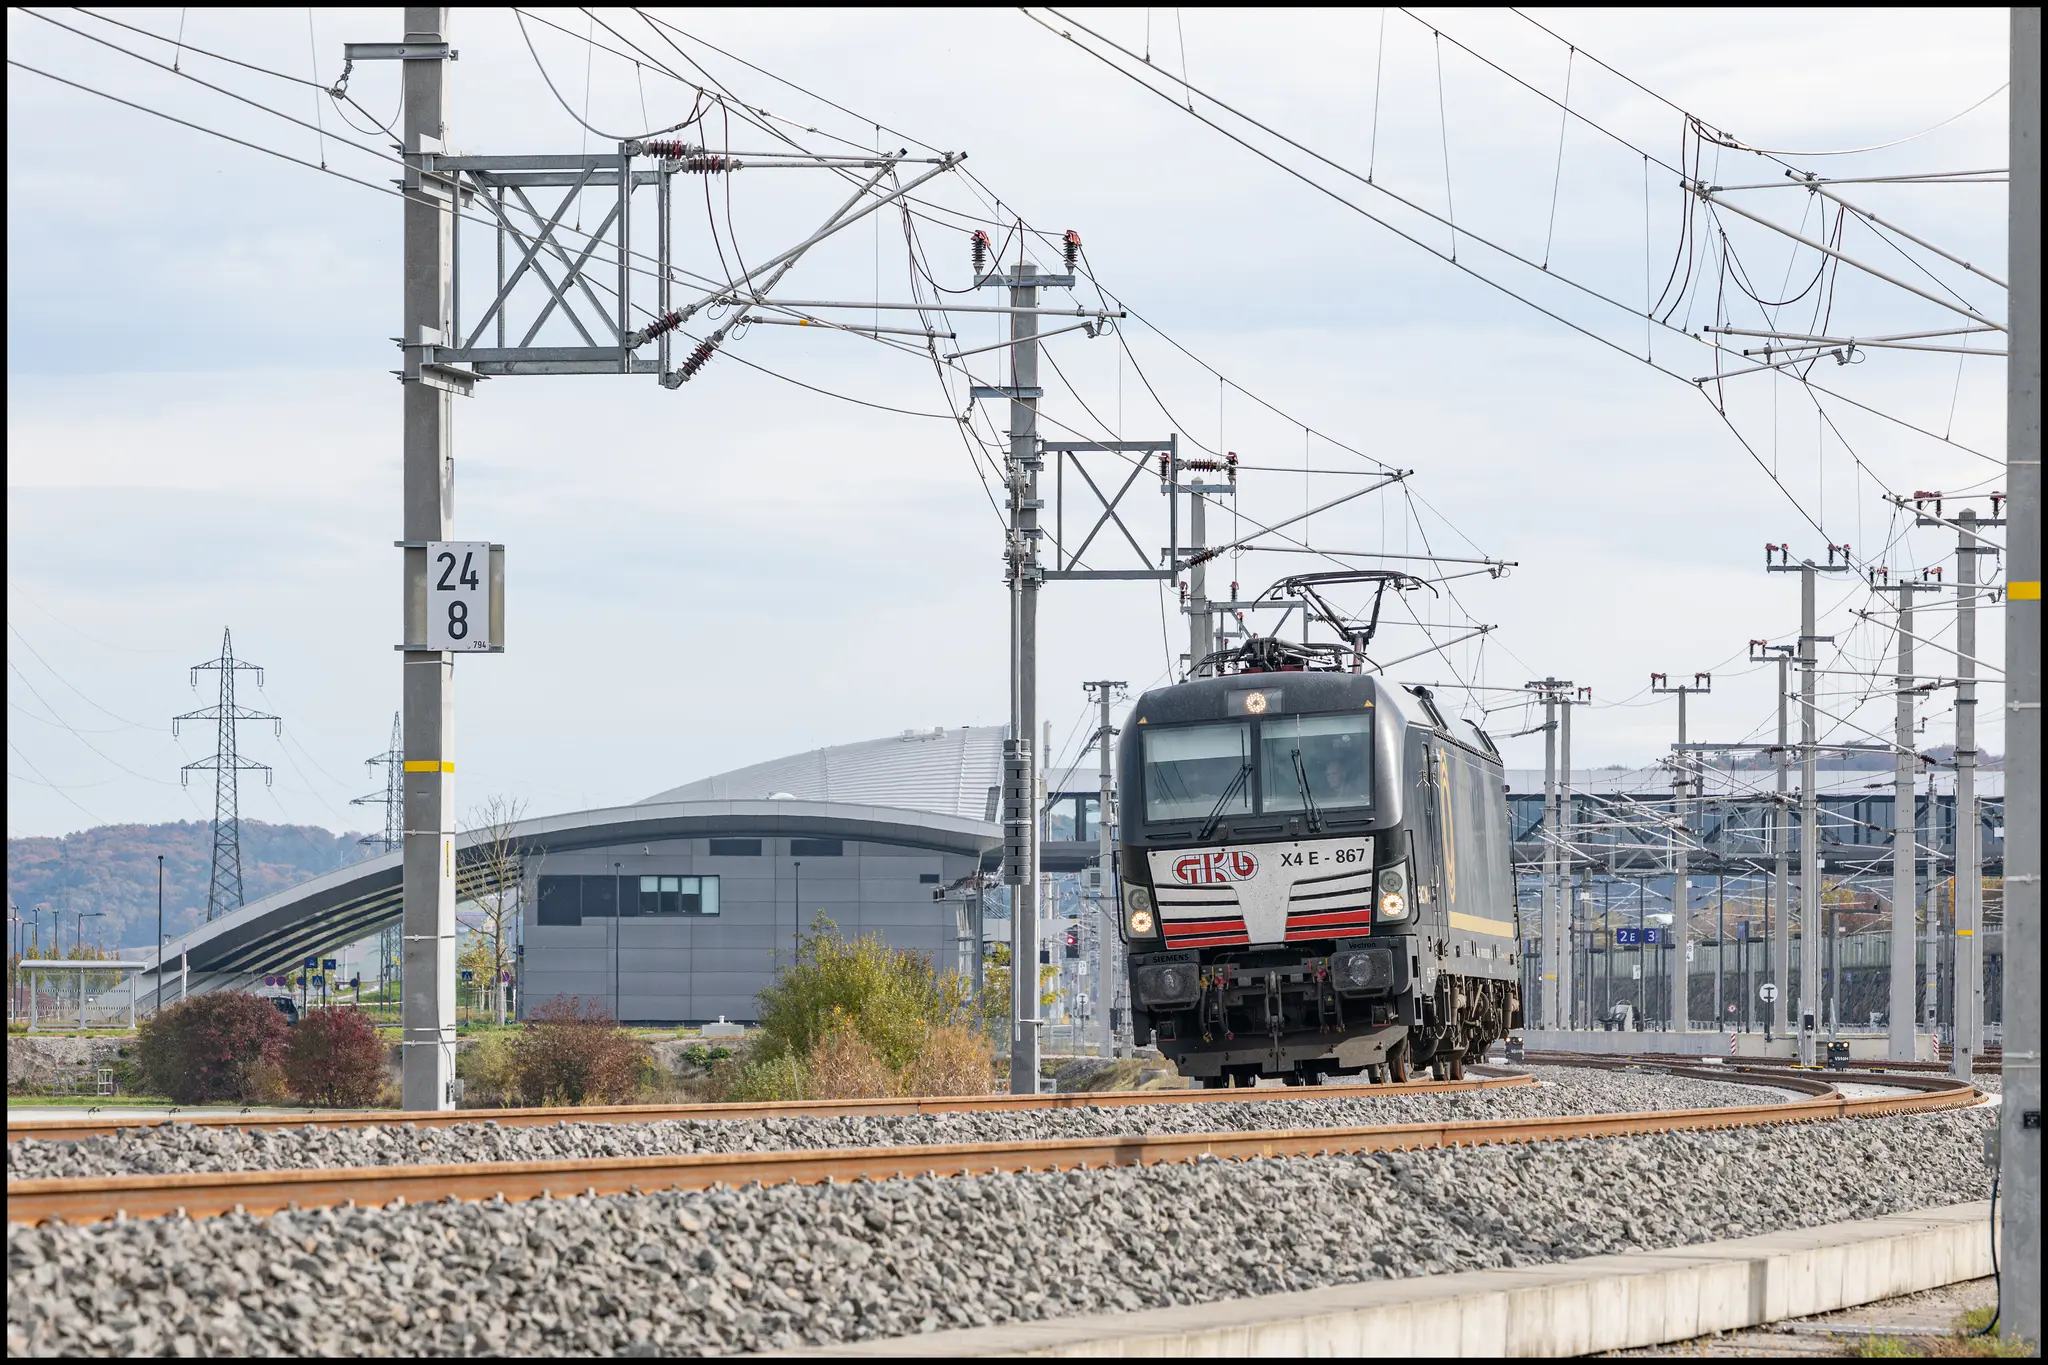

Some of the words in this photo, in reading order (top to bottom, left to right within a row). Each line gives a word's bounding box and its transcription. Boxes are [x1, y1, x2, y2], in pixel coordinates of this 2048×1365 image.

[436, 551, 479, 591] 24
[447, 600, 468, 640] 8
[473, 641, 487, 649] 794
[1280, 852, 1304, 867] X4
[1308, 851, 1320, 865] E
[1335, 848, 1366, 864] 867
[1619, 930, 1628, 942] 2
[1629, 932, 1636, 942] E
[1647, 930, 1655, 942] 3
[1152, 953, 1189, 963] SIEMENS
